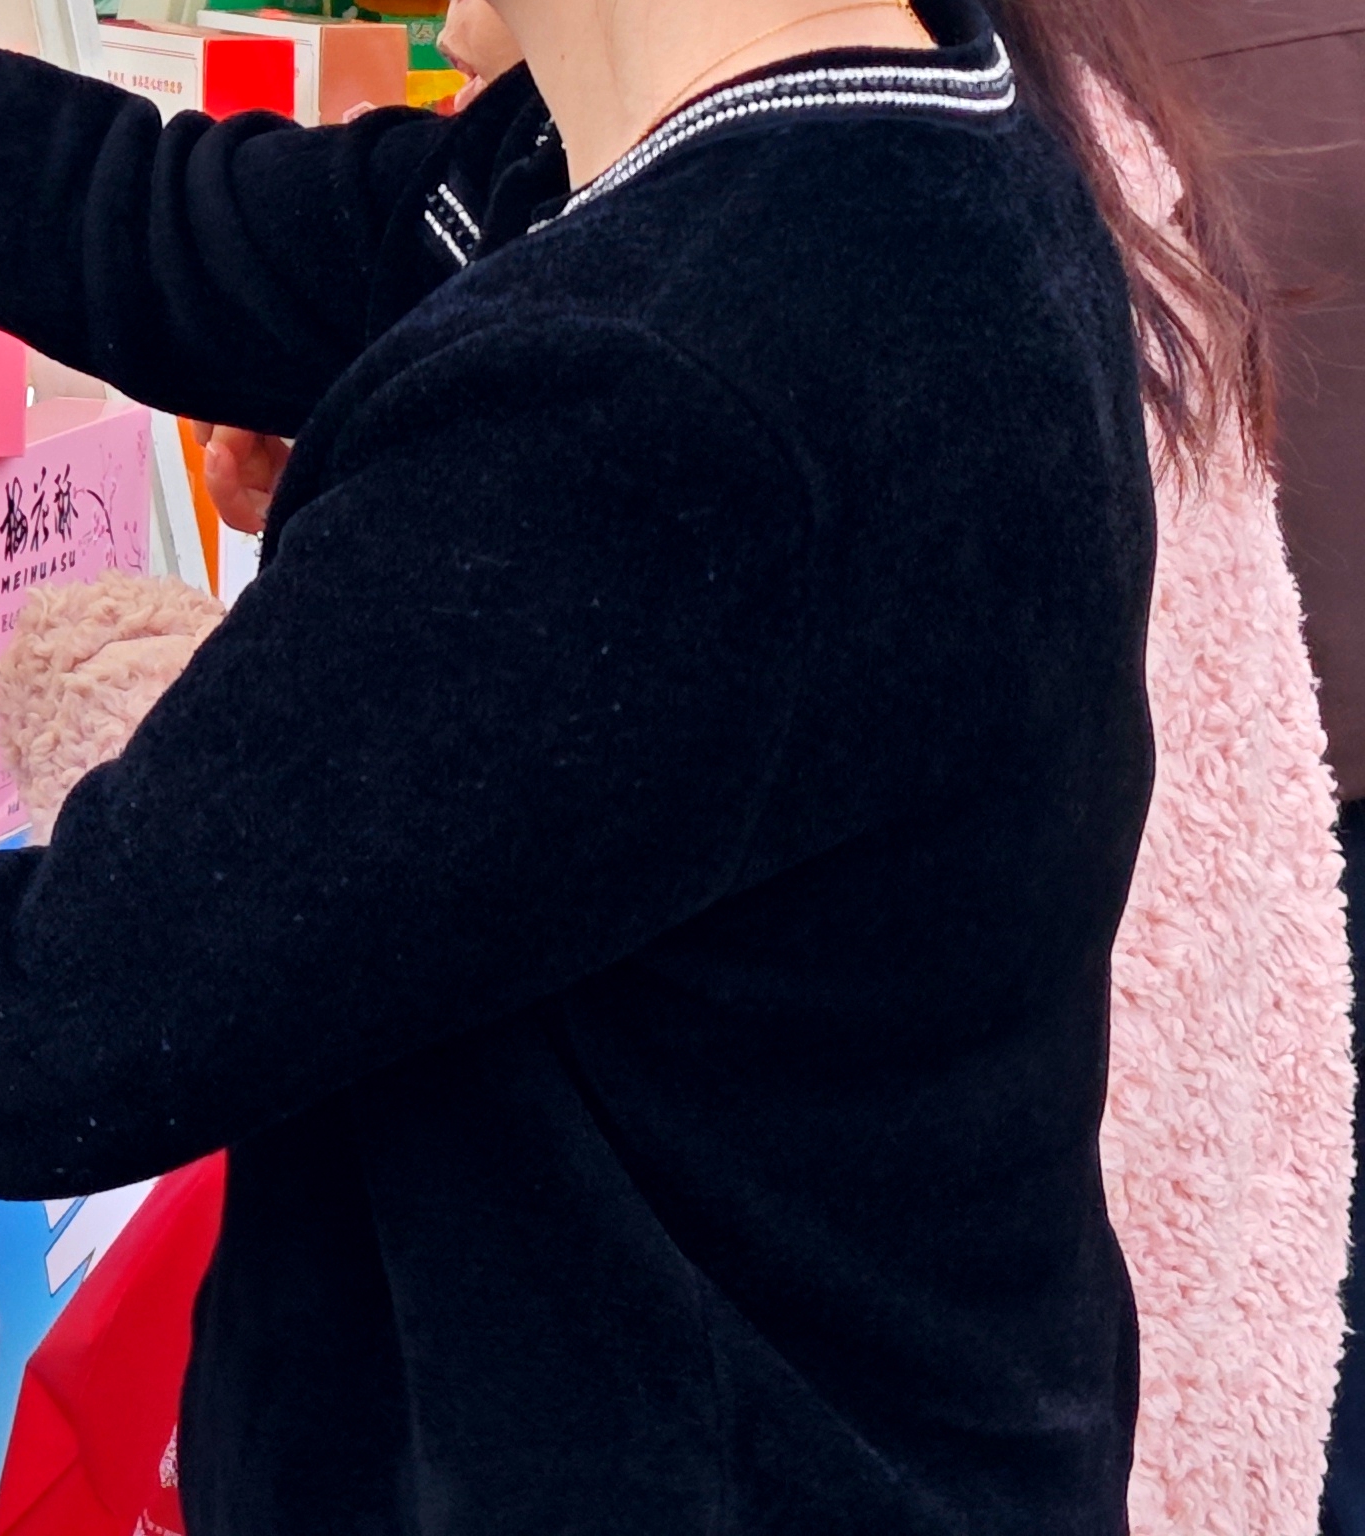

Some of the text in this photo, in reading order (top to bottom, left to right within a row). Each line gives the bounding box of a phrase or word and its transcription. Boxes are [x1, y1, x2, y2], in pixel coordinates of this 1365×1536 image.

[0, 464, 79, 563] 梅花酥
[0, 550, 77, 595] MEIHUASU
